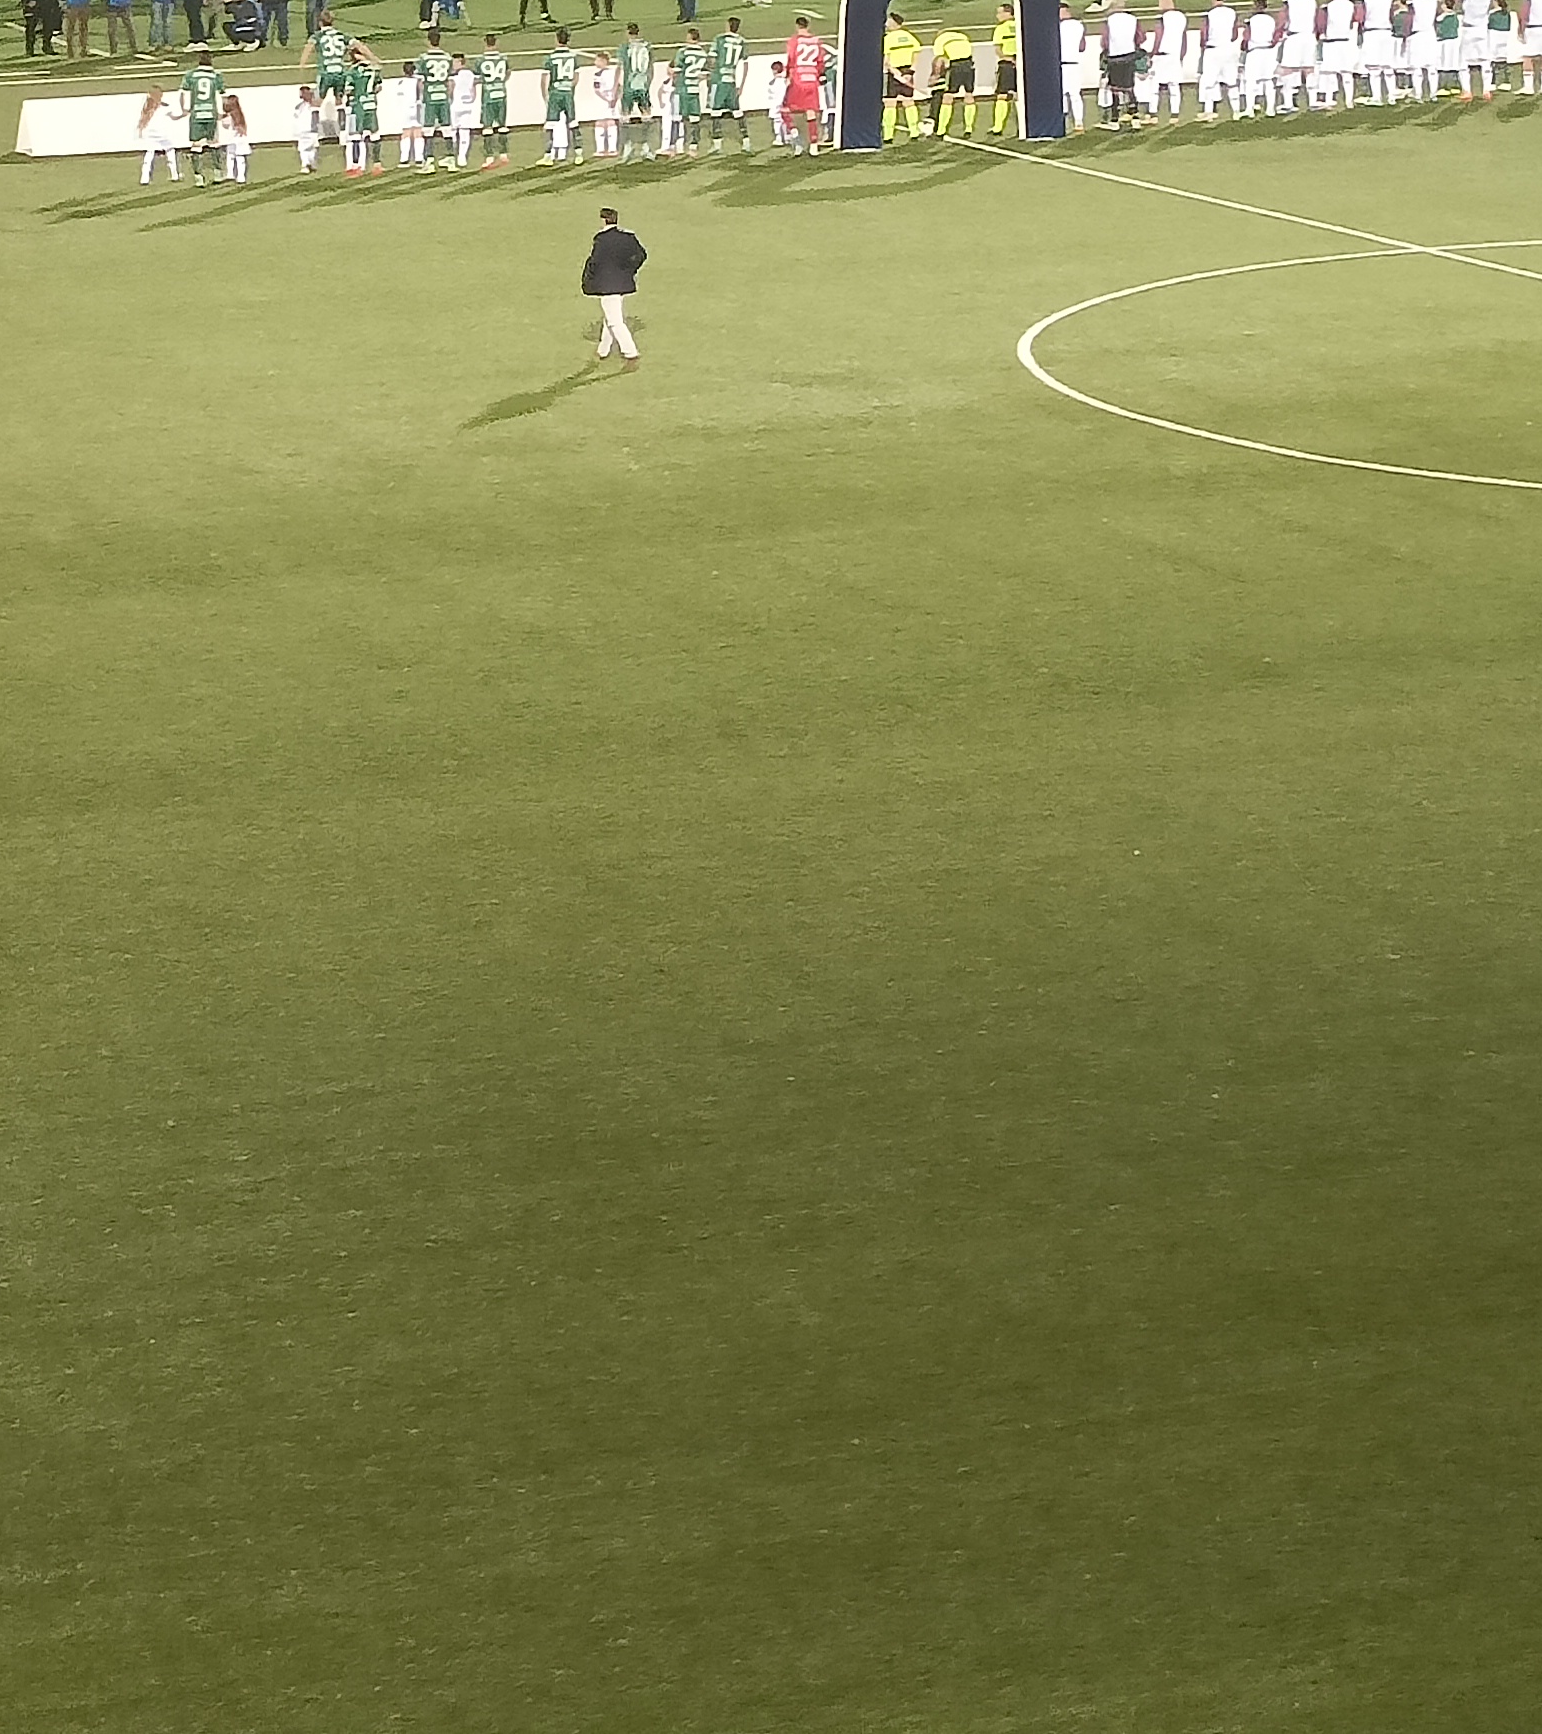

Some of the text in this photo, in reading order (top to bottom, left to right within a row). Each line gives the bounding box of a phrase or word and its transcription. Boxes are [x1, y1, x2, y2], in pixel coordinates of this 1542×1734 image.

[319, 34, 345, 57] 35
[796, 44, 820, 66] 22
[425, 60, 450, 82] 38
[480, 60, 506, 82] 94
[551, 58, 575, 81] 14
[197, 77, 211, 100] 9
[363, 71, 376, 94] 7
